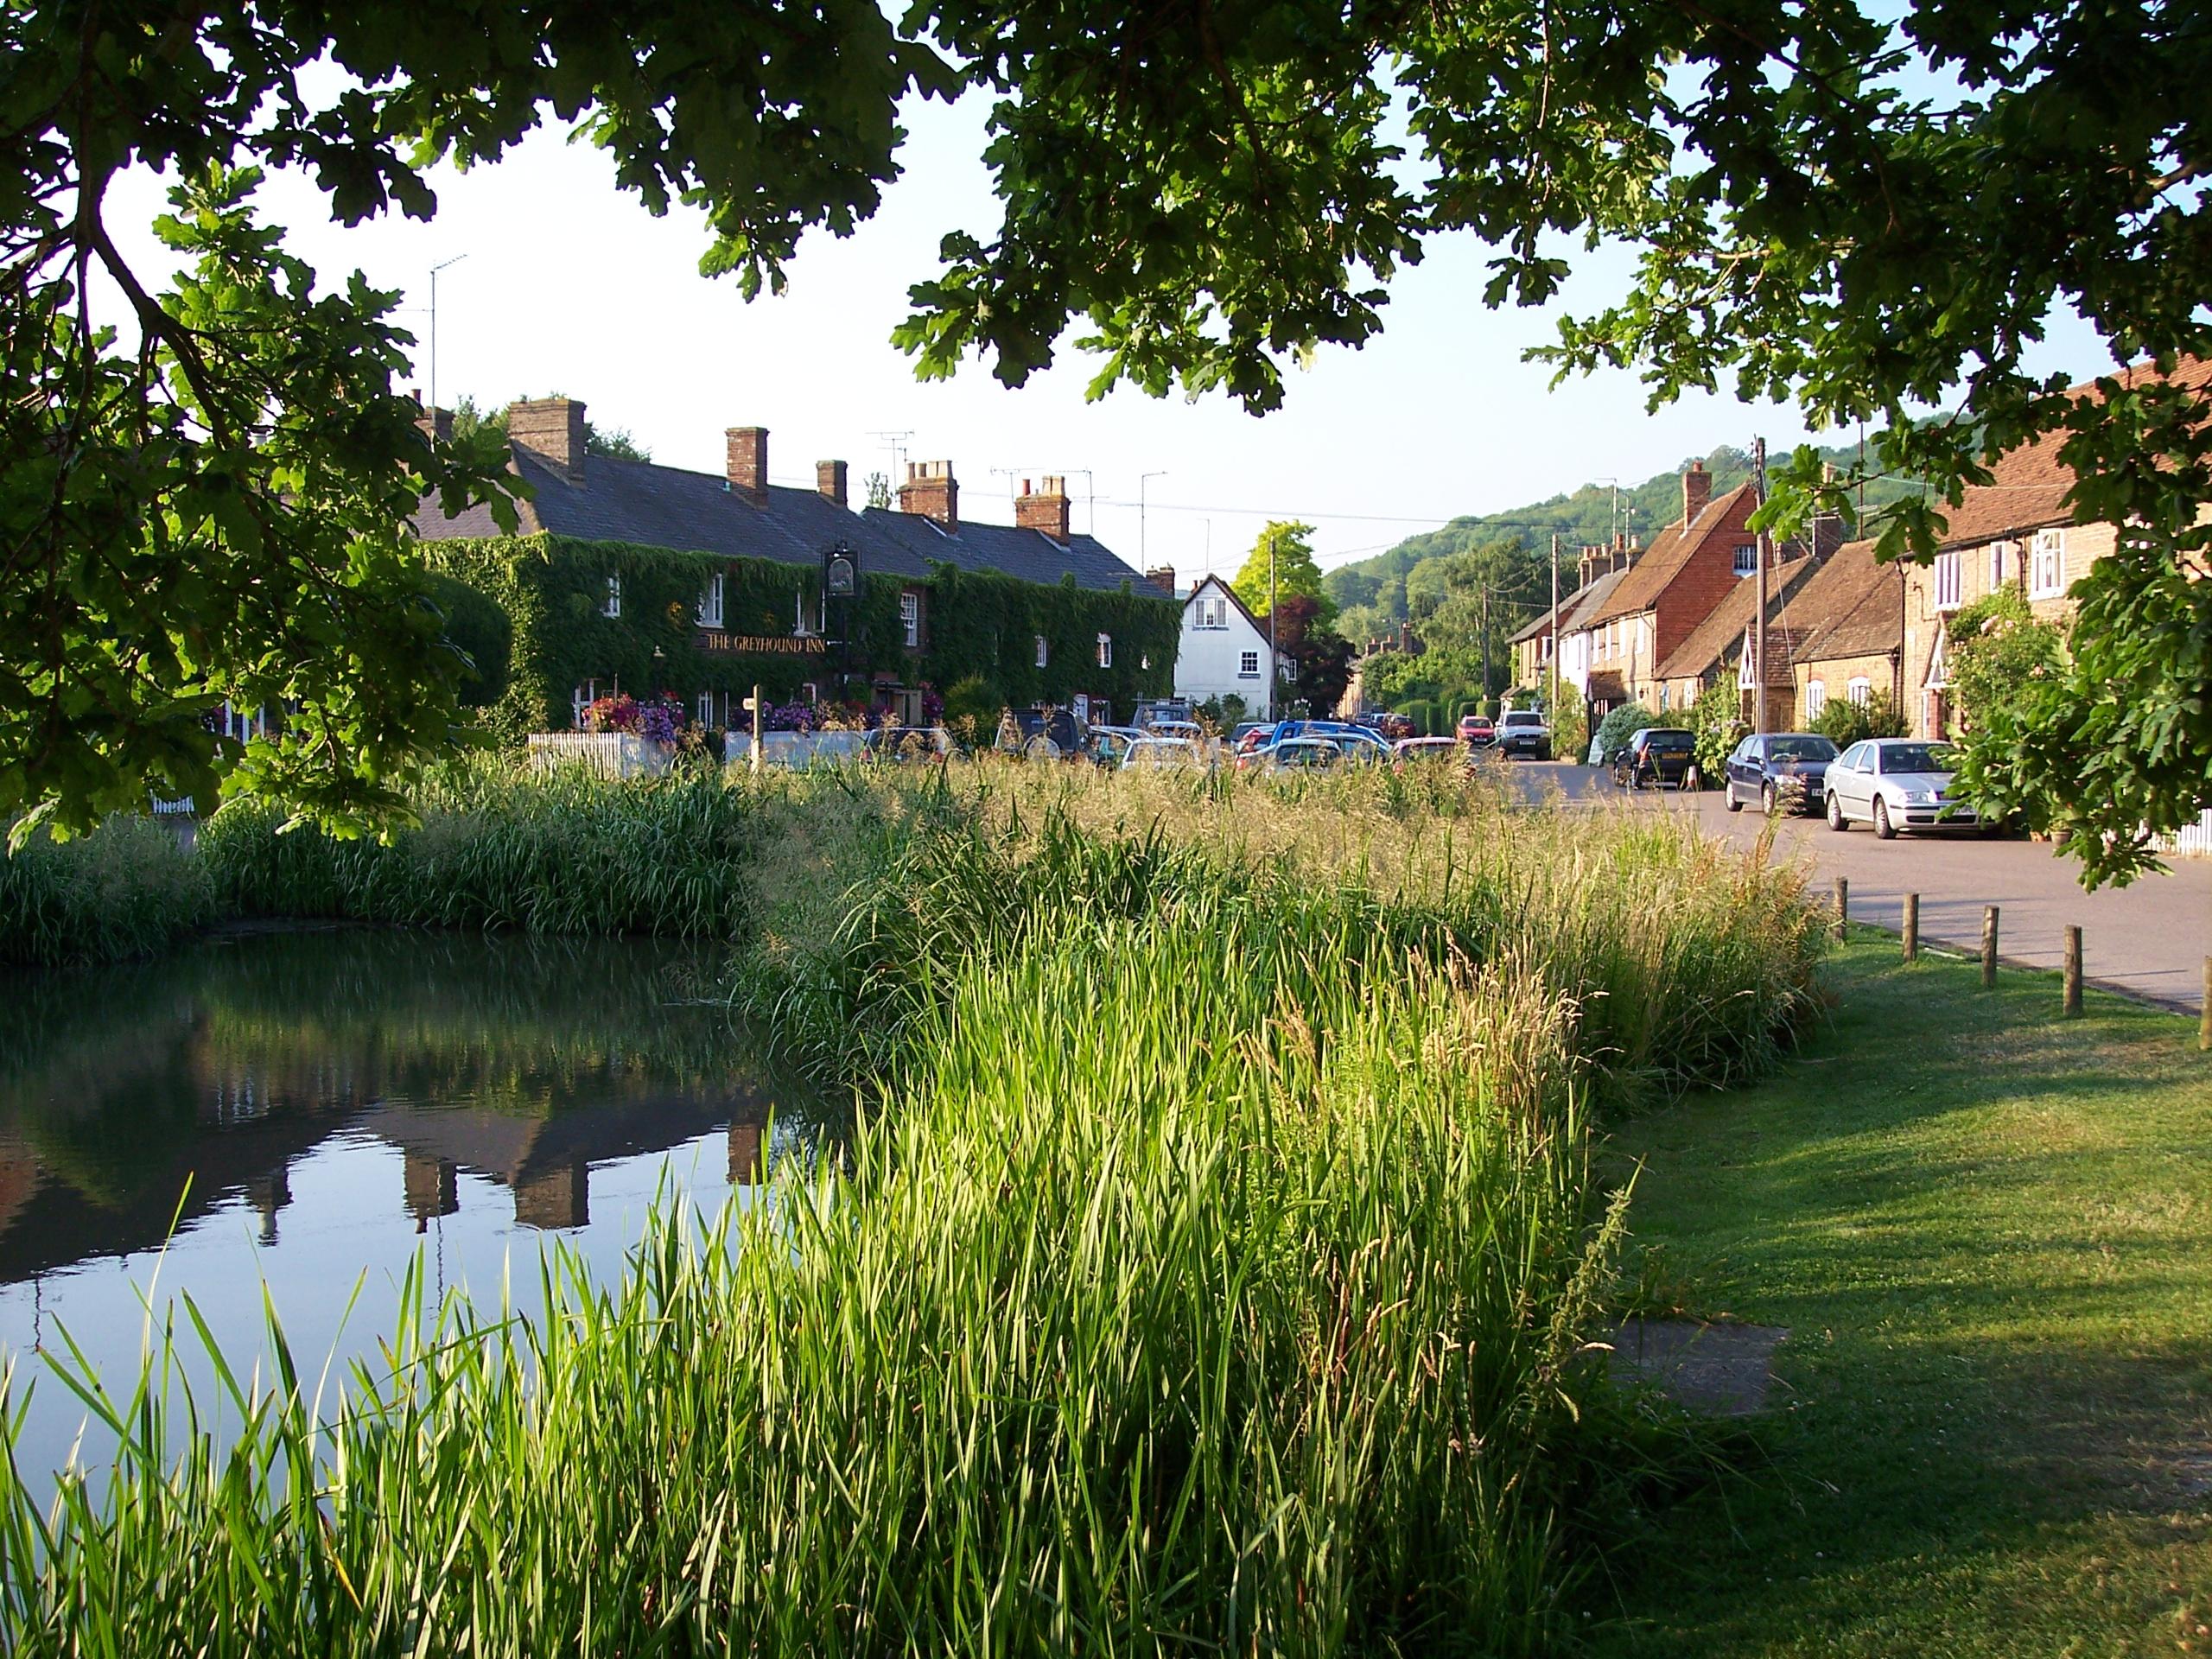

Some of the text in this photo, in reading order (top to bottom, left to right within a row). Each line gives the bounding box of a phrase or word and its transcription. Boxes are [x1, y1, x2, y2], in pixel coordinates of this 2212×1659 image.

[706, 633, 825, 652] THE GREYHOUND INN
